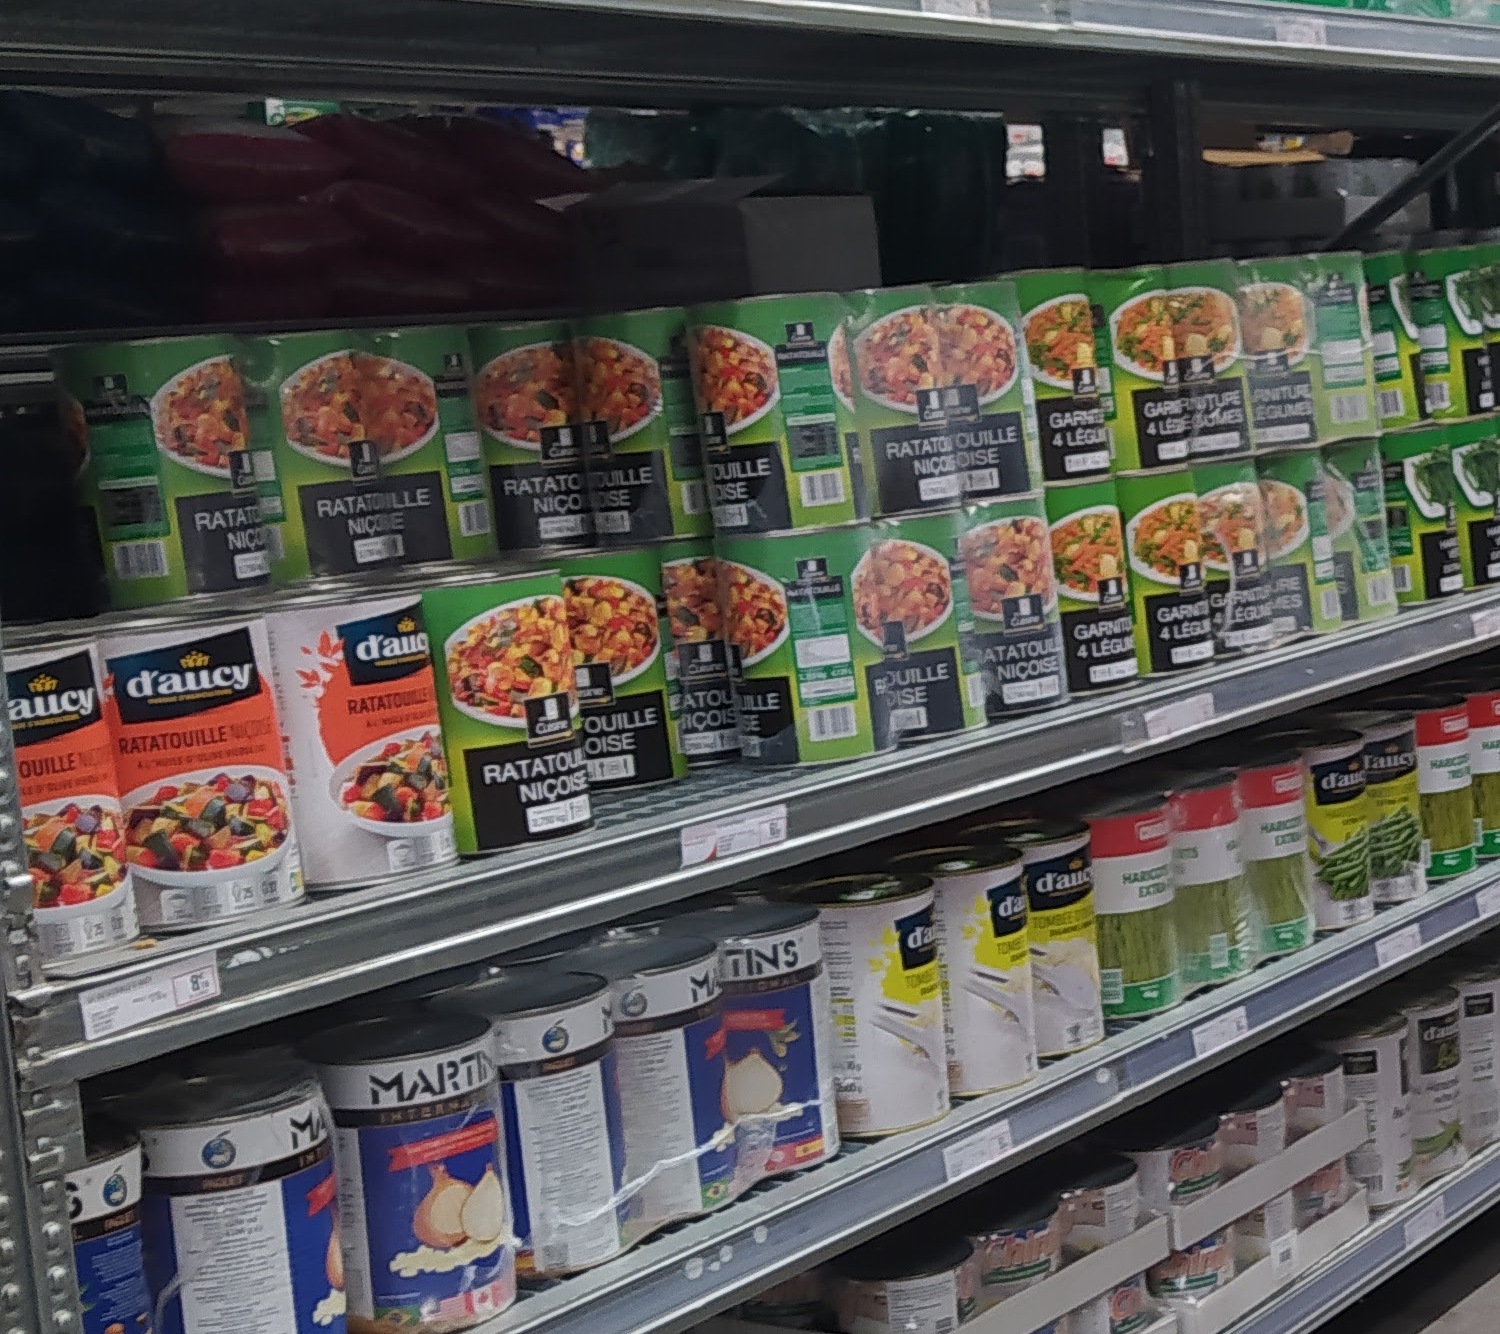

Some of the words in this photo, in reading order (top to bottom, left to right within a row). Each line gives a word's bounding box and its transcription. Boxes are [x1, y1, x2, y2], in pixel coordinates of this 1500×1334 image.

[1158, 626, 1170, 641] 4
[1076, 643, 1088, 658] 4
[126, 662, 254, 699] d'aucy
[584, 707, 658, 734] OUILLE
[118, 724, 228, 755] RATATOUILLE
[584, 732, 637, 755] OISE
[18, 752, 76, 780] OUILLE
